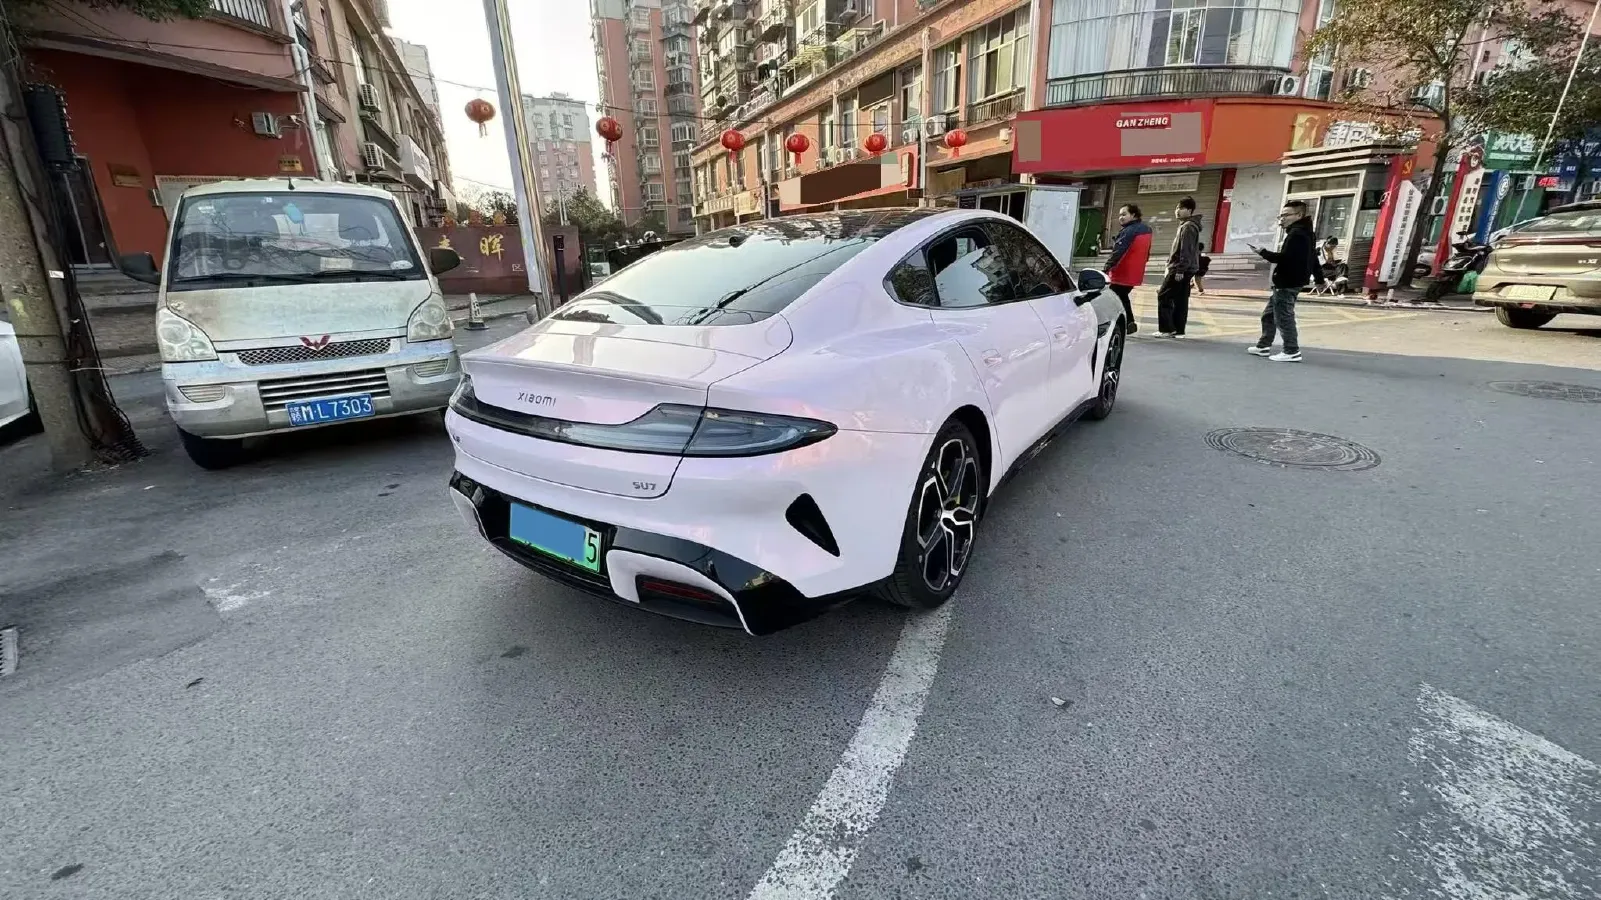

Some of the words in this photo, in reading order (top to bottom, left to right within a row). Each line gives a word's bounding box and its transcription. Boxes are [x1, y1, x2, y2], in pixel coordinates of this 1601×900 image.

[1116, 118, 1137, 128] GAN
[1137, 117, 1169, 127] ZHENG
[632, 481, 656, 491] SU7
